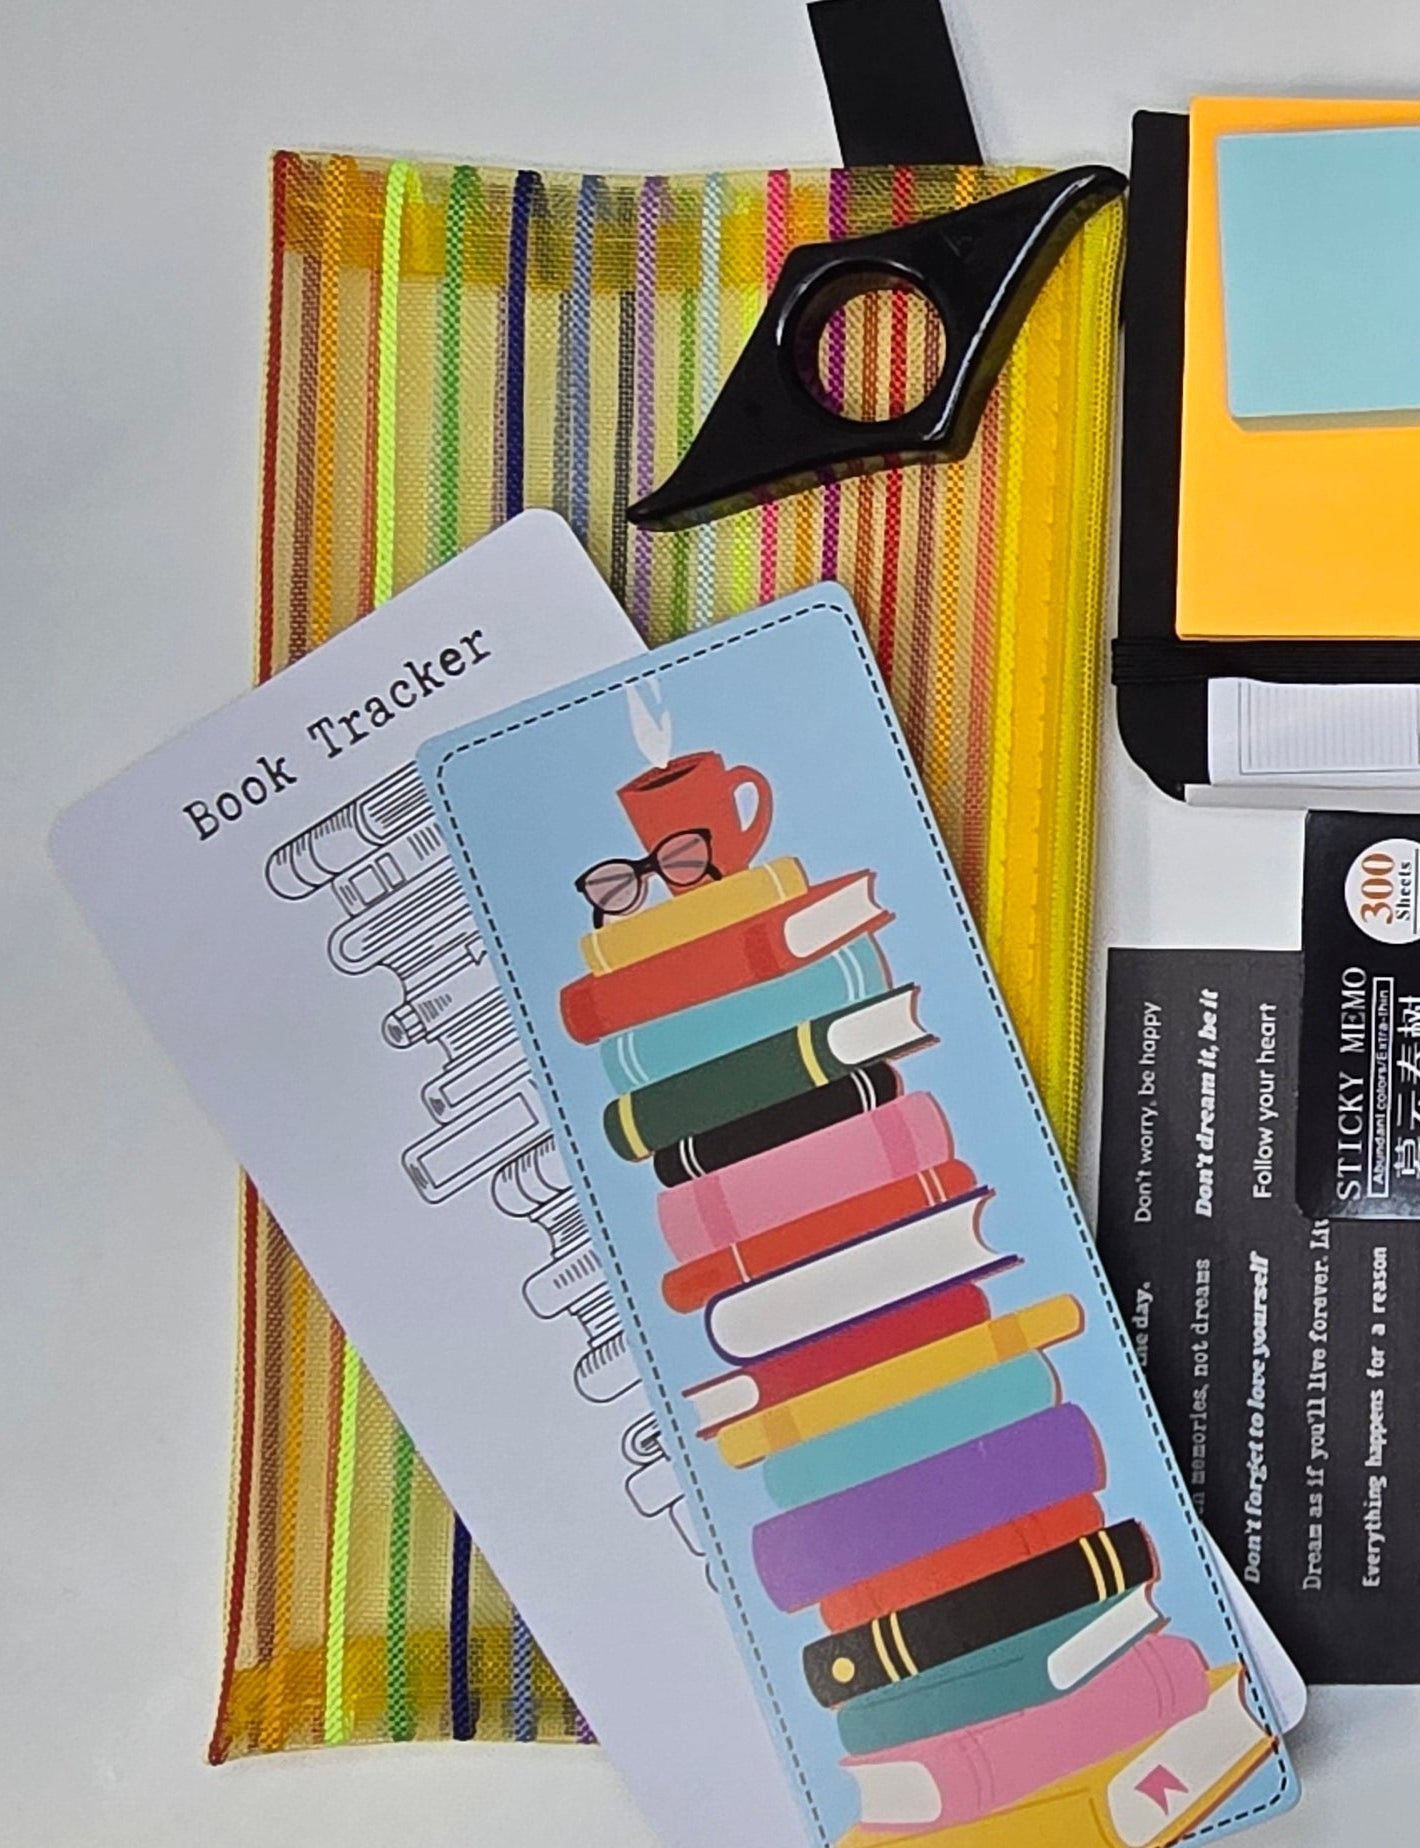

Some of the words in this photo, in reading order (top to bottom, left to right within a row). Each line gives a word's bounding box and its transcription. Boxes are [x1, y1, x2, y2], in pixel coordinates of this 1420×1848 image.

[182, 756, 297, 841] Book
[306, 629, 491, 758] Tracker
[1361, 853, 1394, 924] 300
[1395, 862, 1412, 922] Sheets
[1199, 1011, 1218, 1040] be
[1200, 989, 1218, 1009] it
[1341, 967, 1367, 1053] MEMO
[1140, 1002, 1161, 1064] happy
[1199, 1045, 1220, 1069] it,
[1256, 1003, 1278, 1063] heart
[1138, 1071, 1156, 1095] be
[1196, 1072, 1216, 1150] dream
[1256, 1070, 1279, 1121] your
[1253, 1129, 1274, 1197] Follow
[1337, 1072, 1363, 1200] STICKY
[1134, 1170, 1152, 1222] Don't
[1195, 1152, 1213, 1217] Don't
[1132, 1282, 1153, 1328] day.
[1190, 1258, 1210, 1335] dreams
[1250, 1250, 1270, 1358] yourself
[1310, 1255, 1330, 1343] forever.
[1372, 1247, 1387, 1313] reason
[1192, 1341, 1209, 1376] not
[1371, 1323, 1386, 1336] a
[1247, 1359, 1266, 1410] love
[1308, 1348, 1327, 1392] live
[1367, 1346, 1385, 1378] for
[1189, 1384, 1210, 1484] memories,
[1248, 1413, 1265, 1438] to
[1308, 1398, 1328, 1460] you'll
[1365, 1389, 1387, 1467] happens
[1244, 1441, 1267, 1515] forget
[1307, 1465, 1323, 1486] if
[1309, 1493, 1323, 1518] as
[1244, 1517, 1263, 1583] Don't
[1303, 1524, 1323, 1590] Dream
[1362, 1475, 1386, 1587] Everything
